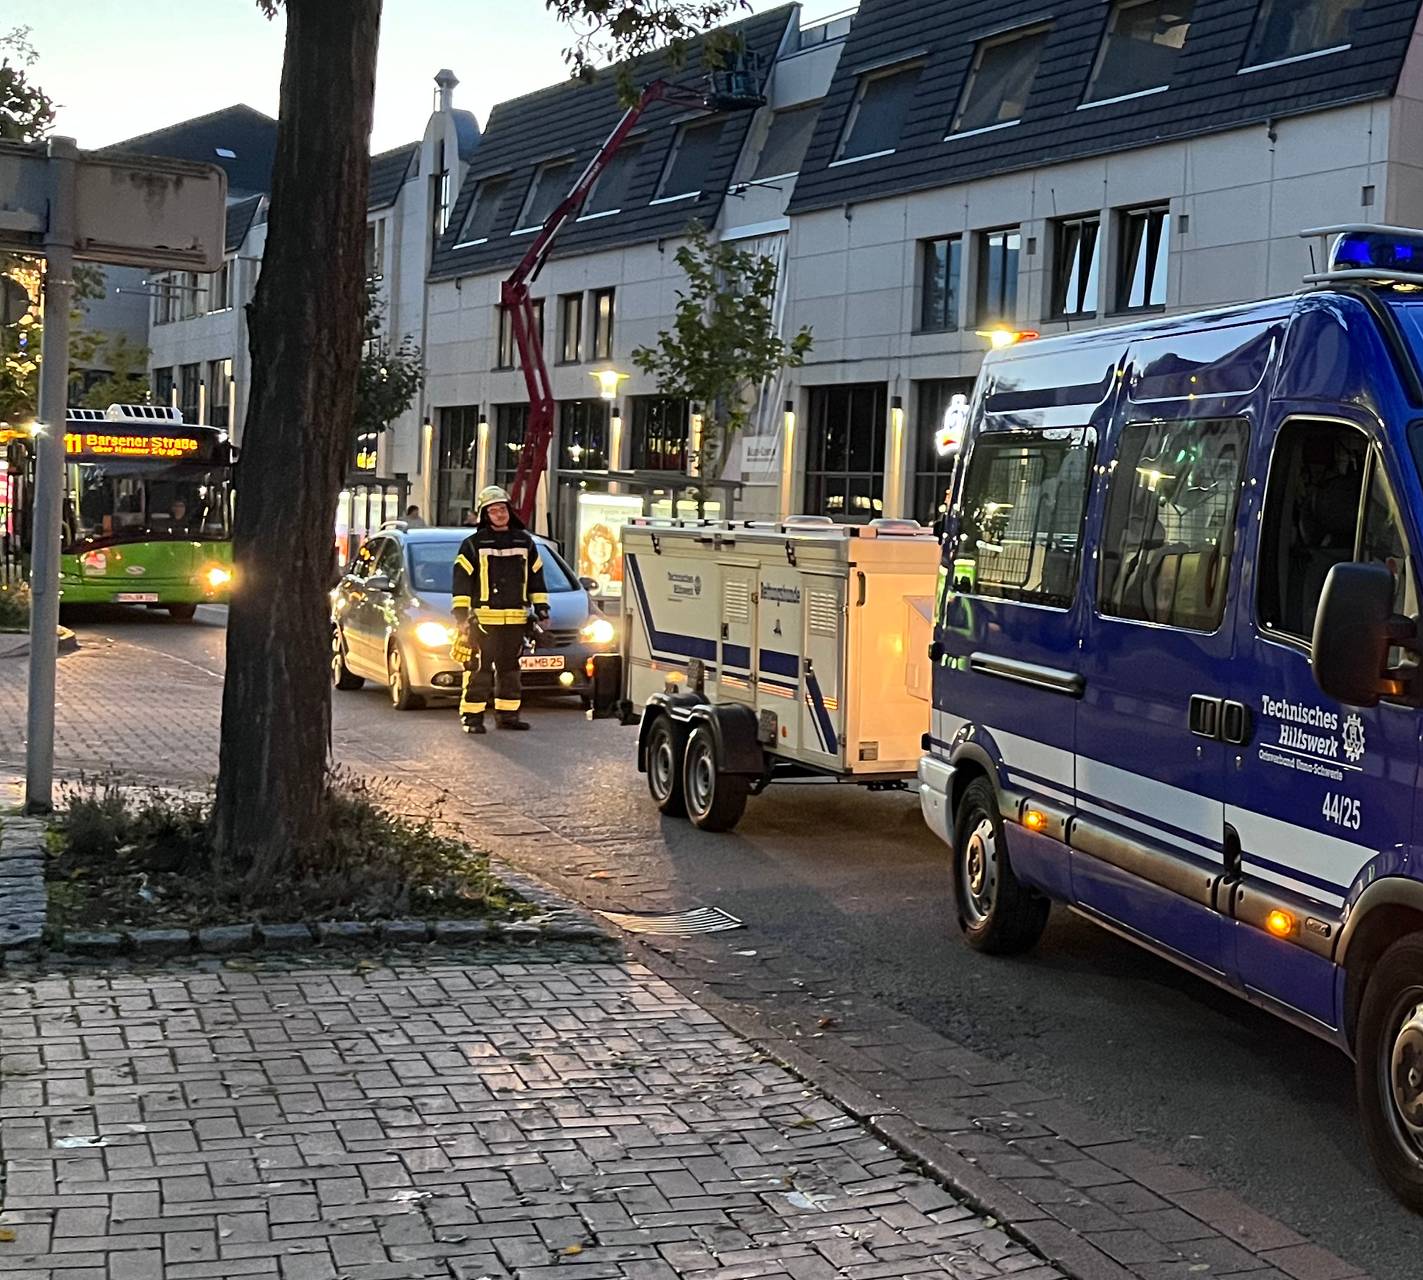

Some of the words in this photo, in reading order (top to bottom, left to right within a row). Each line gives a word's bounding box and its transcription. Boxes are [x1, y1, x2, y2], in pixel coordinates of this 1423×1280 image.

[64, 433, 82, 453] 11
[86, 434, 149, 448] Barsener
[151, 436, 198, 450] Straße
[550, 657, 563, 667] 25
[1261, 694, 1339, 731] Technisches
[1278, 724, 1339, 758] Hilfswerk
[1322, 791, 1361, 830] 44/25
